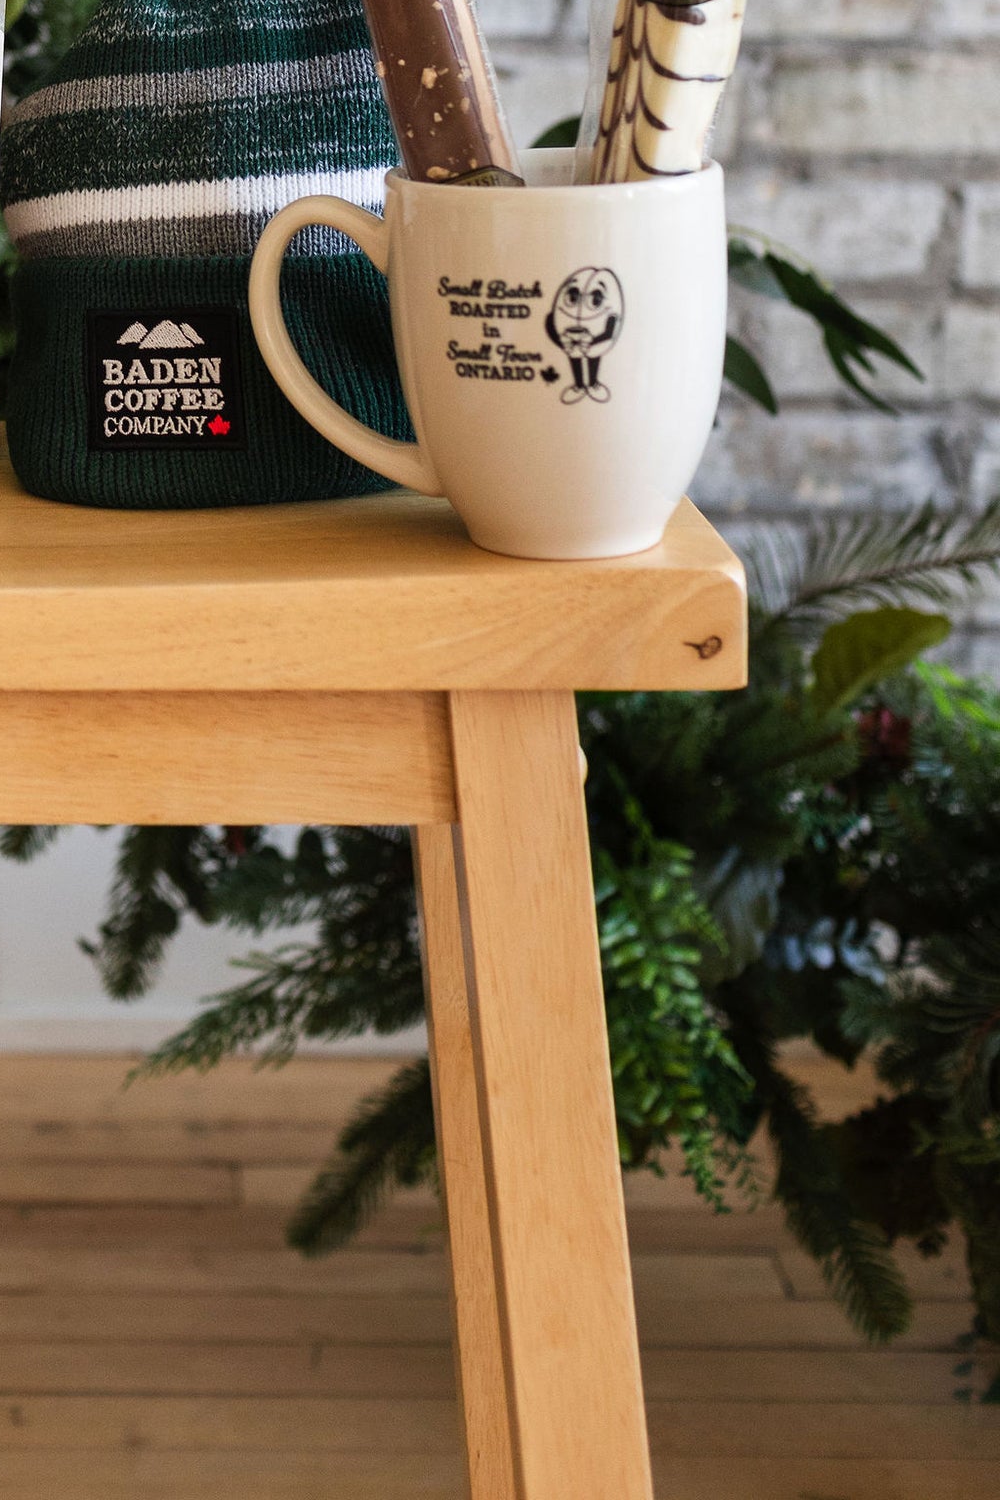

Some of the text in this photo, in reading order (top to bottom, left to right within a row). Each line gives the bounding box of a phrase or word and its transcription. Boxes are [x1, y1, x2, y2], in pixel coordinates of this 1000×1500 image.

[437, 276, 543, 300] Small Batch
[449, 301, 531, 319] ROASTED
[482, 322, 502, 339] in
[446, 340, 543, 364] Small Town
[102, 357, 222, 385] BADEN
[455, 364, 536, 381] ONTARIO
[104, 388, 225, 413] COFFEE
[103, 415, 208, 438] COMPANY
